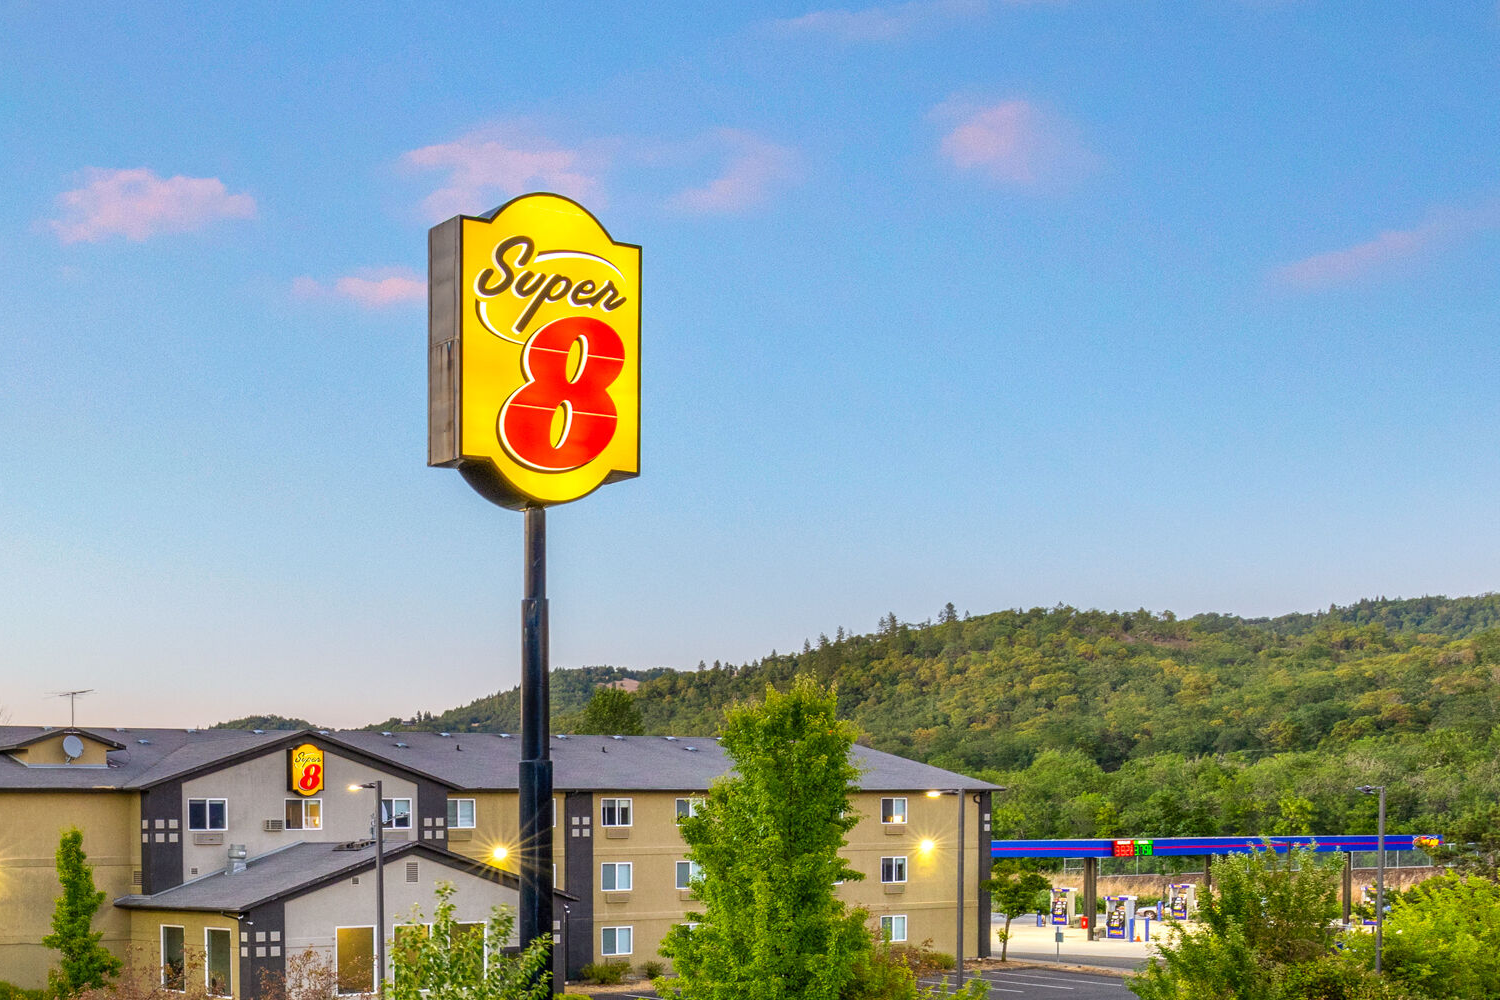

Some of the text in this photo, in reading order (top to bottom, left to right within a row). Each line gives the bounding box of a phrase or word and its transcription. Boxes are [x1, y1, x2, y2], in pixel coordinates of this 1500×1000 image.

[476, 235, 627, 334] Super
[498, 316, 626, 473] 8
[295, 751, 321, 768] Super
[299, 764, 321, 790] 8
